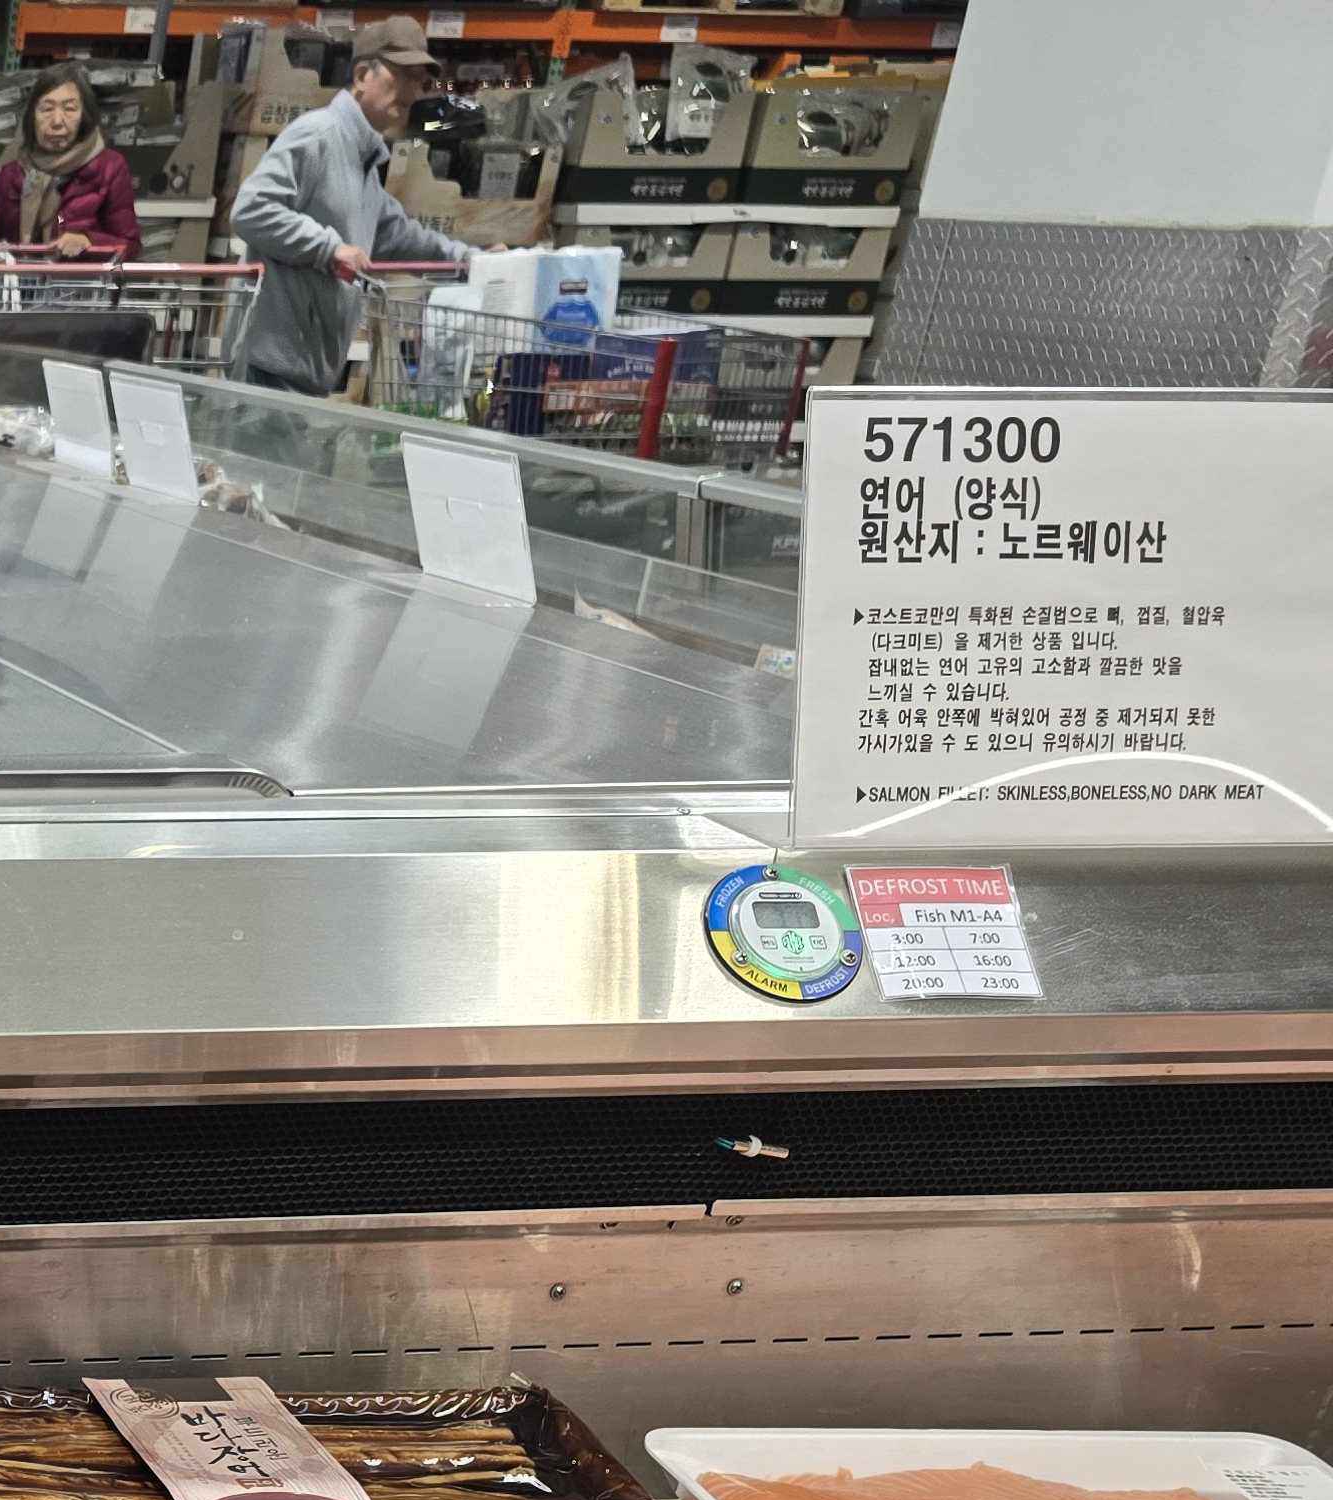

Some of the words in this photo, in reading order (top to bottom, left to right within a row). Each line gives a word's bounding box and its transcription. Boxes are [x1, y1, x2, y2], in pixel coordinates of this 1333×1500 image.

[864, 417, 1060, 463] 571300
[861, 477, 924, 519] 연어
[953, 476, 1040, 521] (양식)
[859, 521, 959, 563] 원산지
[999, 521, 1166, 563] 노르웨이산
[867, 607, 959, 626] 코스트코만의
[969, 606, 1013, 626] 특화된
[1023, 606, 1097, 625] 손질법으로
[1138, 606, 1169, 625] 껍질,
[872, 632, 942, 652] (다크미트)
[955, 633, 968, 651] 을
[978, 632, 1022, 651] 제거한
[1032, 632, 1062, 651] 상품
[1072, 632, 1117, 650] 입니다.
[869, 658, 929, 677] 잡내없는
[939, 658, 967, 676] 연어
[978, 657, 1022, 676] 고유의
[1032, 657, 1090, 676] 고소함과
[1100, 657, 1143, 676] 깔끔한
[1153, 657, 1182, 675] 맛을
[868, 683, 912, 702] 느끼실
[923, 683, 936, 702] 수
[947, 683, 1009, 701] 있습니다.
[859, 709, 889, 728] 간혹
[899, 709, 927, 727] 어육
[938, 708, 980, 727] 안쪽에
[991, 708, 1049, 727] 박혀있어
[1060, 708, 1086, 727] 공정
[1096, 709, 1108, 727] 중
[1117, 708, 1178, 726] 제거되지
[1187, 708, 1215, 726] 못한
[942, 734, 955, 753] 수
[964, 735, 978, 750] 도
[988, 733, 1032, 752] 있으니
[1043, 733, 1114, 752] 유의하시기
[1124, 733, 1185, 751] 바랍니다.
[869, 787, 929, 802] SALMON
[1179, 785, 1217, 799] DARK
[1225, 785, 1264, 799] MEAT
[715, 876, 744, 908] FROZEN
[799, 876, 835, 906] FRESH
[859, 878, 948, 897] DEFROST
[956, 879, 1005, 896] TIME
[915, 909, 946, 923] Fish
[950, 910, 1003, 922] M1-A4
[891, 933, 924, 945] 3:00
[969, 933, 1000, 944] 7:00
[896, 955, 935, 968] 12:00
[974, 955, 1012, 966] 16:00
[745, 969, 789, 992] ALARM
[804, 966, 849, 995] DEFROST
[982, 977, 1019, 989] 23:00
[183, 1406, 268, 1478] 바다장어
